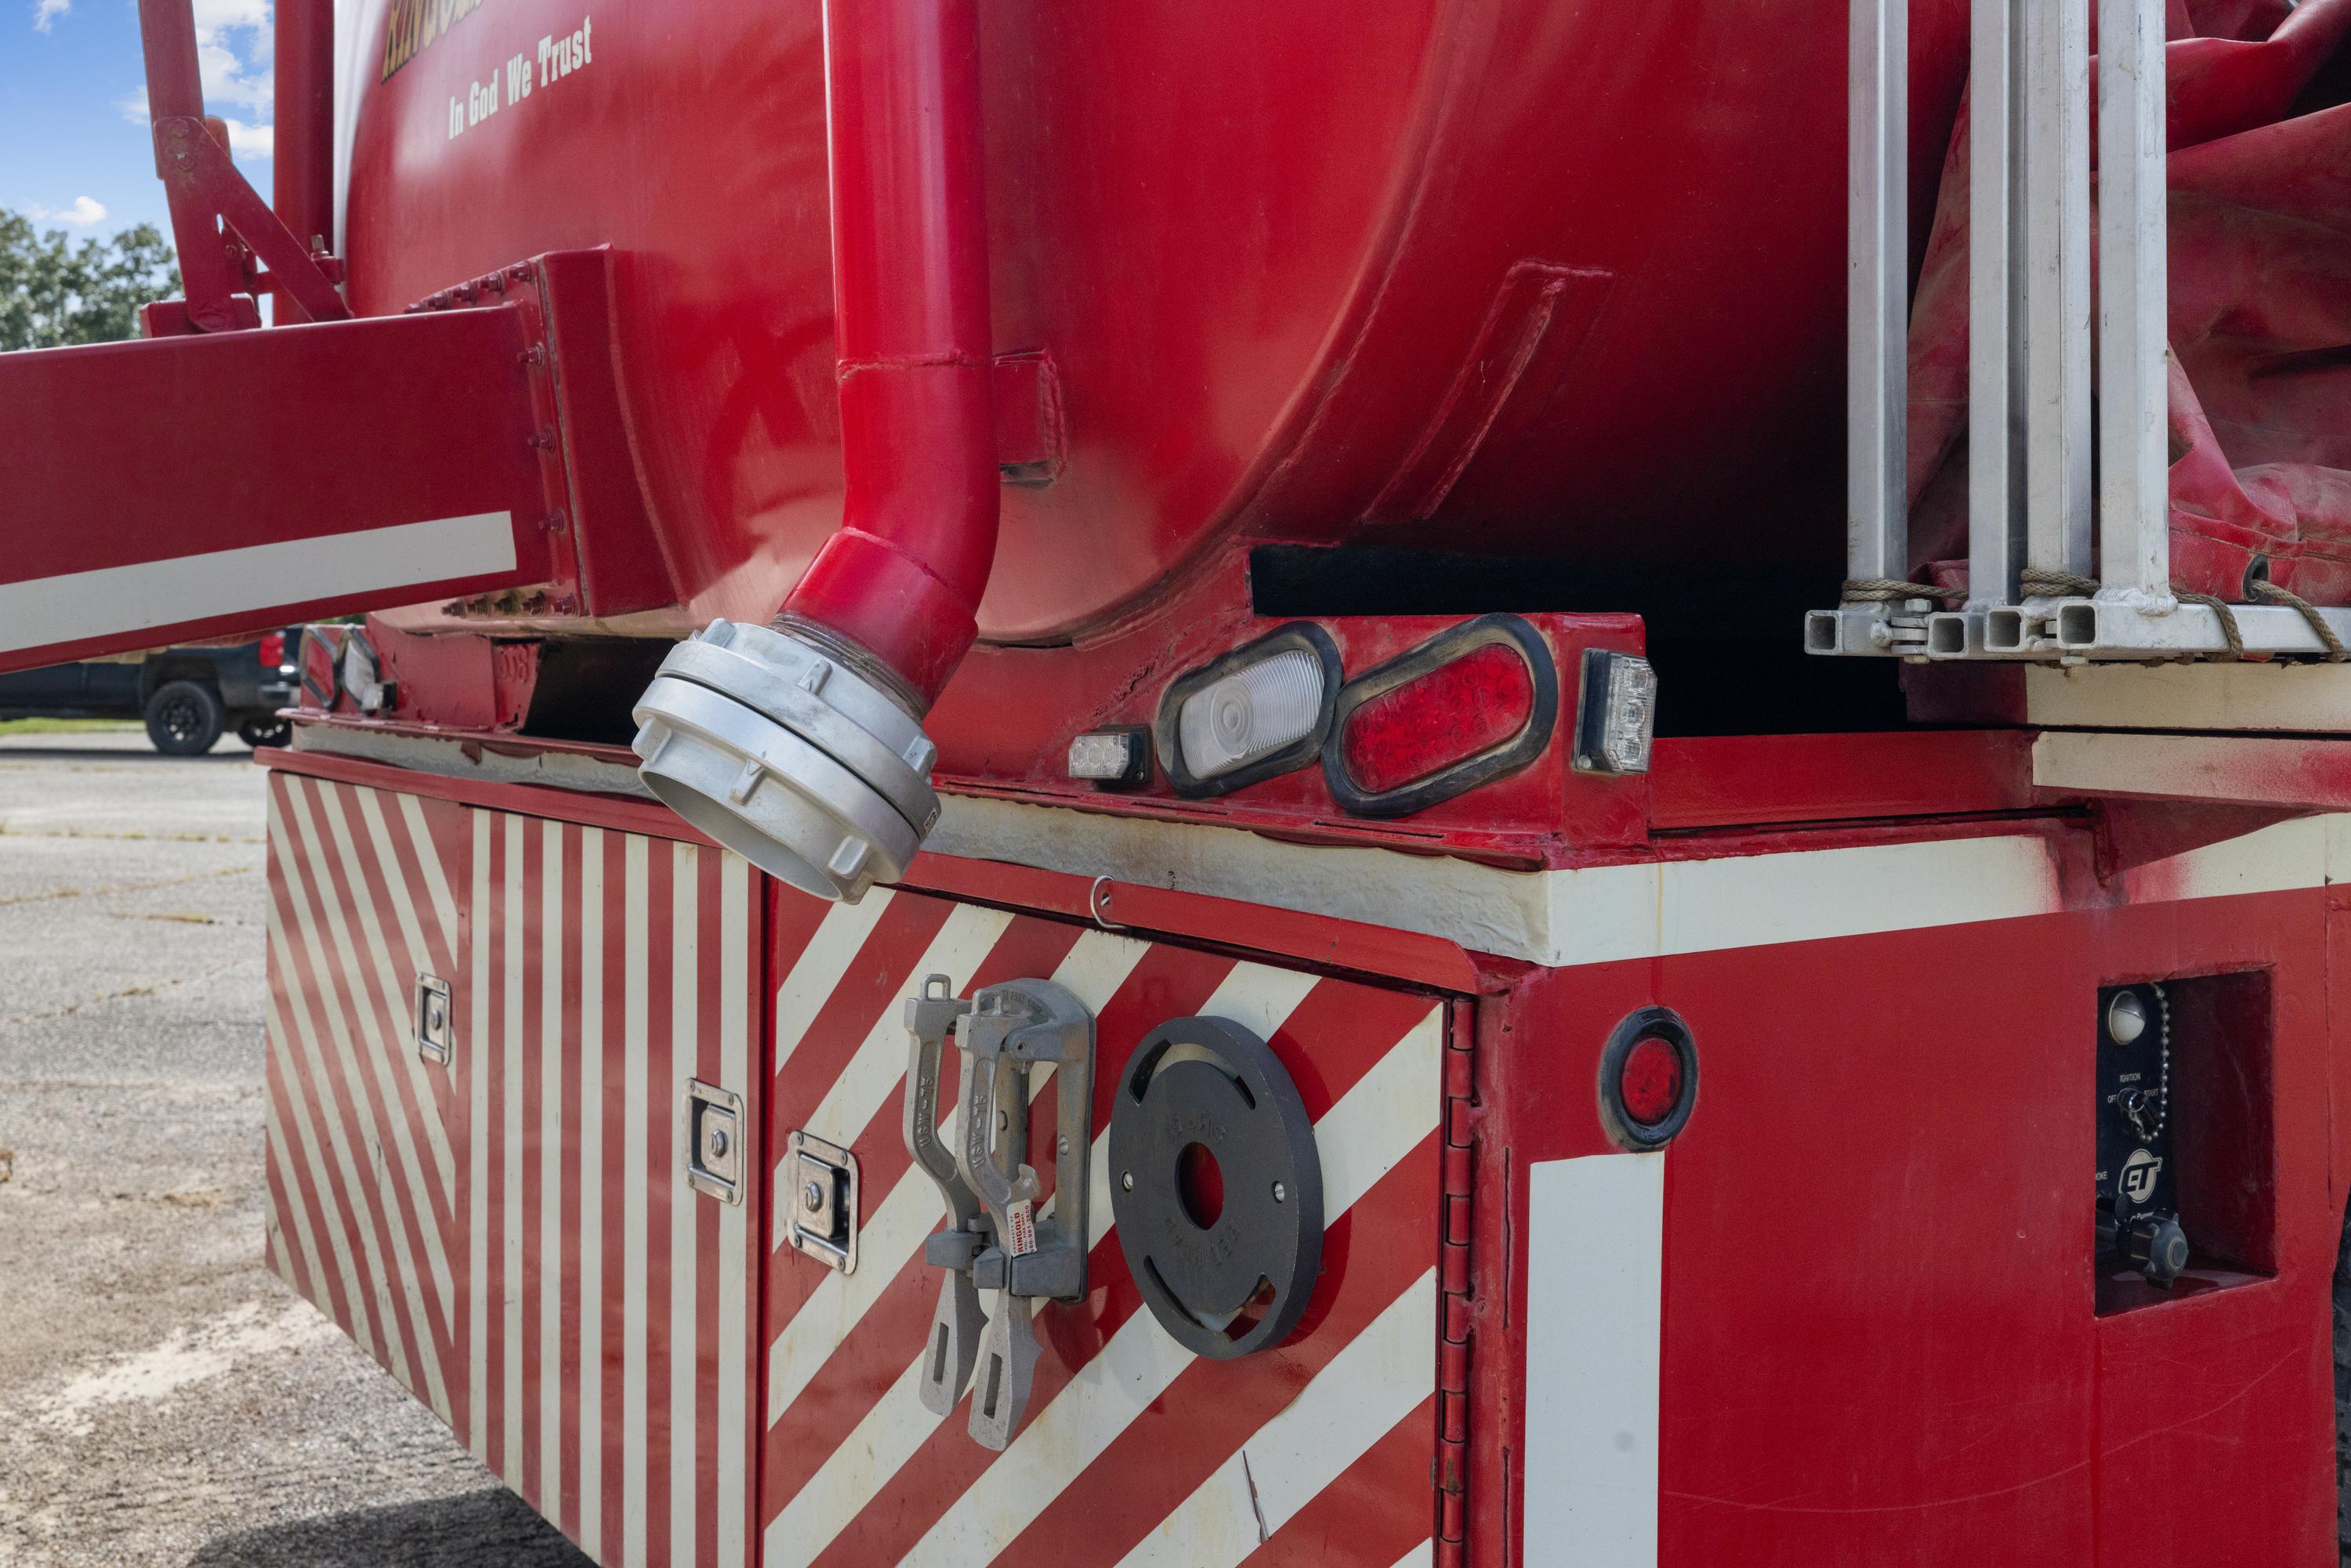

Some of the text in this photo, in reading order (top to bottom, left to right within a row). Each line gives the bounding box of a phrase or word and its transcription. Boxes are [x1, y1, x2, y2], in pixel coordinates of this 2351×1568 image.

[448, 96, 464, 140] In
[469, 67, 498, 127] God
[507, 53, 532, 107] We
[538, 14, 592, 89] Trust
[2119, 1072, 2141, 1083] IGNITION
[2143, 1088, 2159, 1098] START
[1014, 1212, 1023, 1253] RINGOLD
